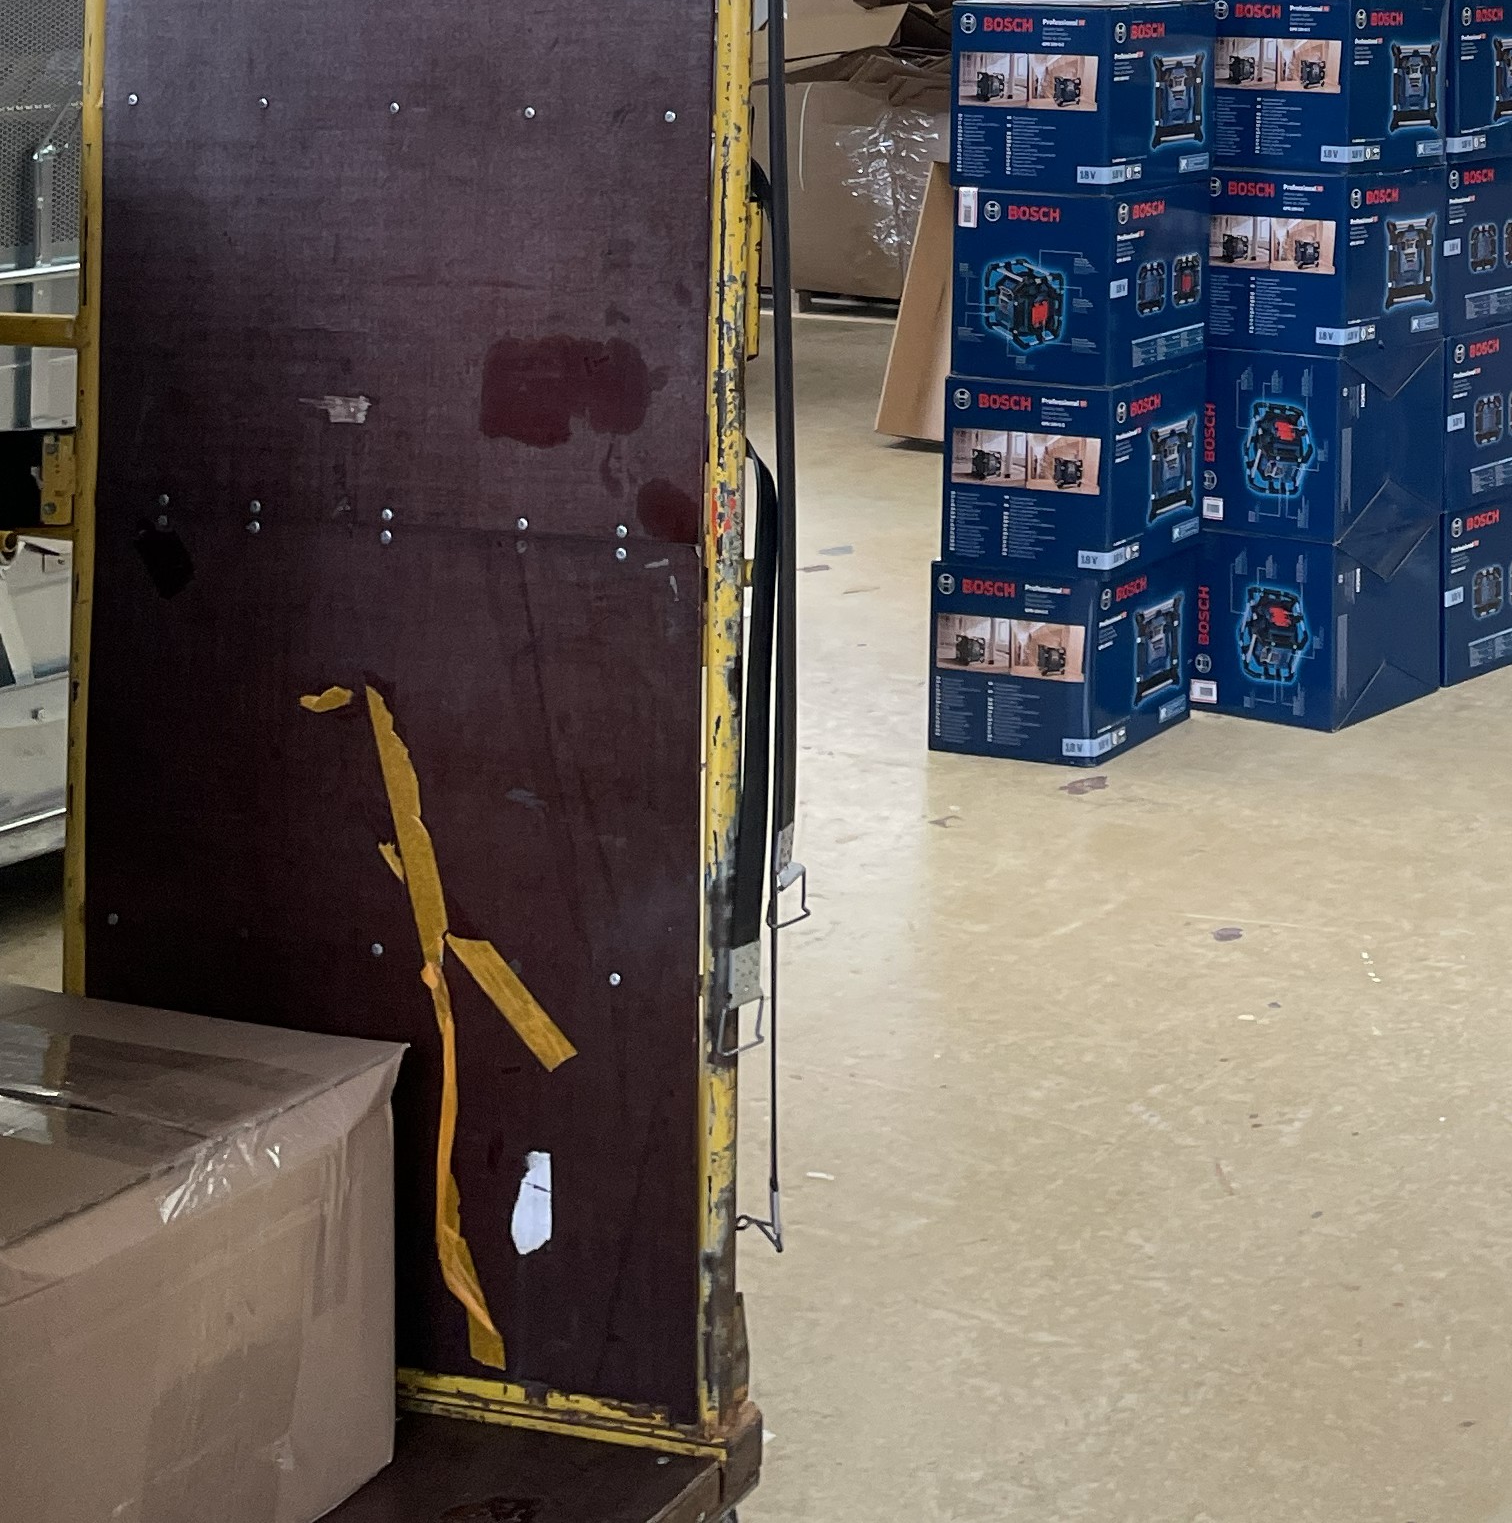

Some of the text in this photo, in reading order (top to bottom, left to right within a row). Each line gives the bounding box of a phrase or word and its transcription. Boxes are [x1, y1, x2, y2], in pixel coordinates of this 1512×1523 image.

[1235, 3, 1281, 18] BOSCH
[1370, 11, 1404, 26] BOSCH
[1475, 8, 1504, 22] BOSCH
[983, 16, 1034, 32] BOSCH
[1130, 22, 1165, 39] BOSCH
[1463, 168, 1494, 184] BOSCH
[1227, 181, 1275, 196] BOSCH
[1365, 188, 1399, 204] BOSCH
[1008, 205, 1060, 221] BOSCH
[1132, 201, 1165, 219] BOSCH
[1469, 338, 1500, 357] BOSCH
[978, 393, 1032, 411] BOSCH
[1130, 394, 1161, 417] BOSCH
[1204, 403, 1216, 463] BOSCH
[1466, 509, 1500, 531] BOSCH
[962, 578, 1016, 597] BOSCH
[1115, 577, 1147, 602] BOSCH
[1198, 586, 1210, 645] BOSCH
